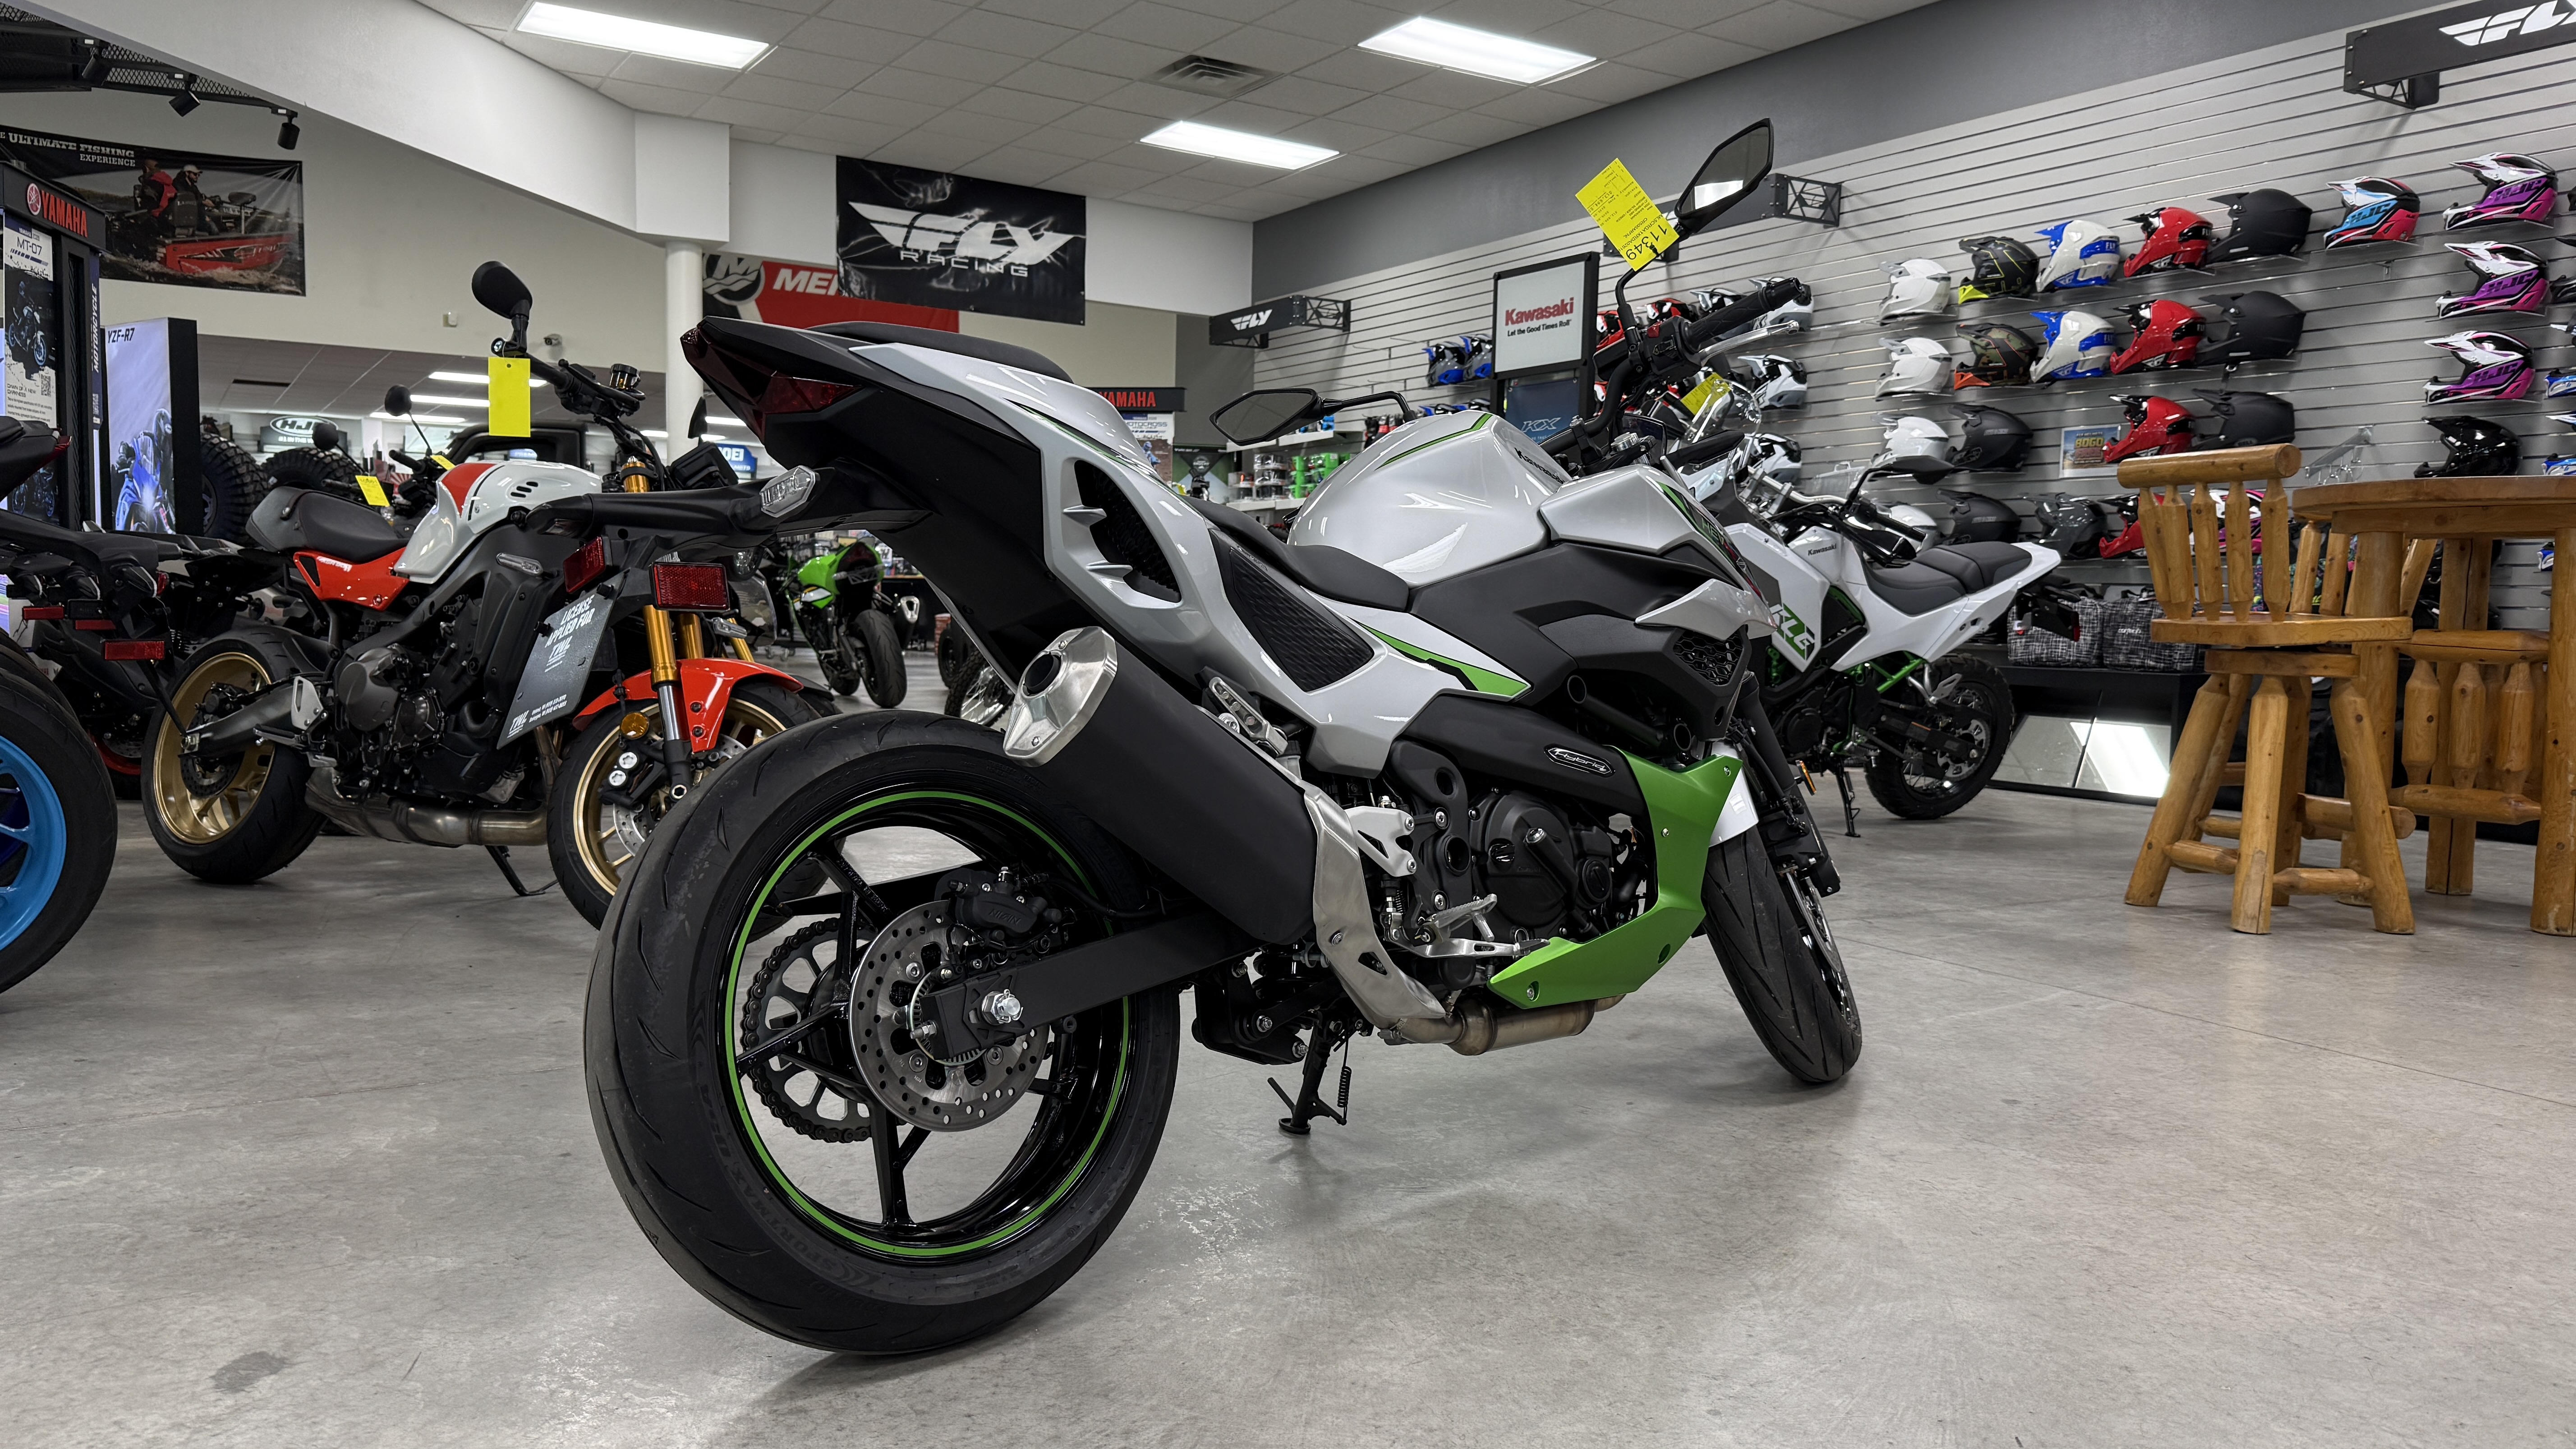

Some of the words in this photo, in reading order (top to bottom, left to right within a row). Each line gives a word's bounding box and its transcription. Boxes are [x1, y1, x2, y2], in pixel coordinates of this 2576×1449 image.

[9, 133, 77, 150] ULTIMATE
[80, 144, 134, 158] FISHING
[80, 154, 135, 167] EXPERIENCE
[2495, 179, 2542, 201] HJC
[41, 190, 88, 237] YAMAHA
[2351, 202, 2392, 222] HJC
[848, 202, 1074, 265] FLY
[1624, 222, 1669, 262] 11349
[17, 236, 42, 255] MT-07
[900, 251, 1028, 277] RACING
[2487, 272, 2534, 292] HJC
[1230, 309, 1272, 331] FLY
[1505, 297, 1574, 326] Kawasaki
[108, 327, 135, 344] YZF-R7
[1527, 325, 1541, 333] Good
[1542, 322, 1558, 331] Times
[2474, 362, 2518, 382] HJC
[1521, 417, 1561, 432] KX
[2076, 437, 2104, 448] BOGO
[1808, 543, 1837, 556] Kawasaki
[560, 594, 595, 626] LICENSE
[545, 617, 578, 648] APPLIED
[575, 607, 595, 630] FOR
[1555, 750, 1606, 771] Hybrid
[989, 909, 1021, 926] NISSIN
